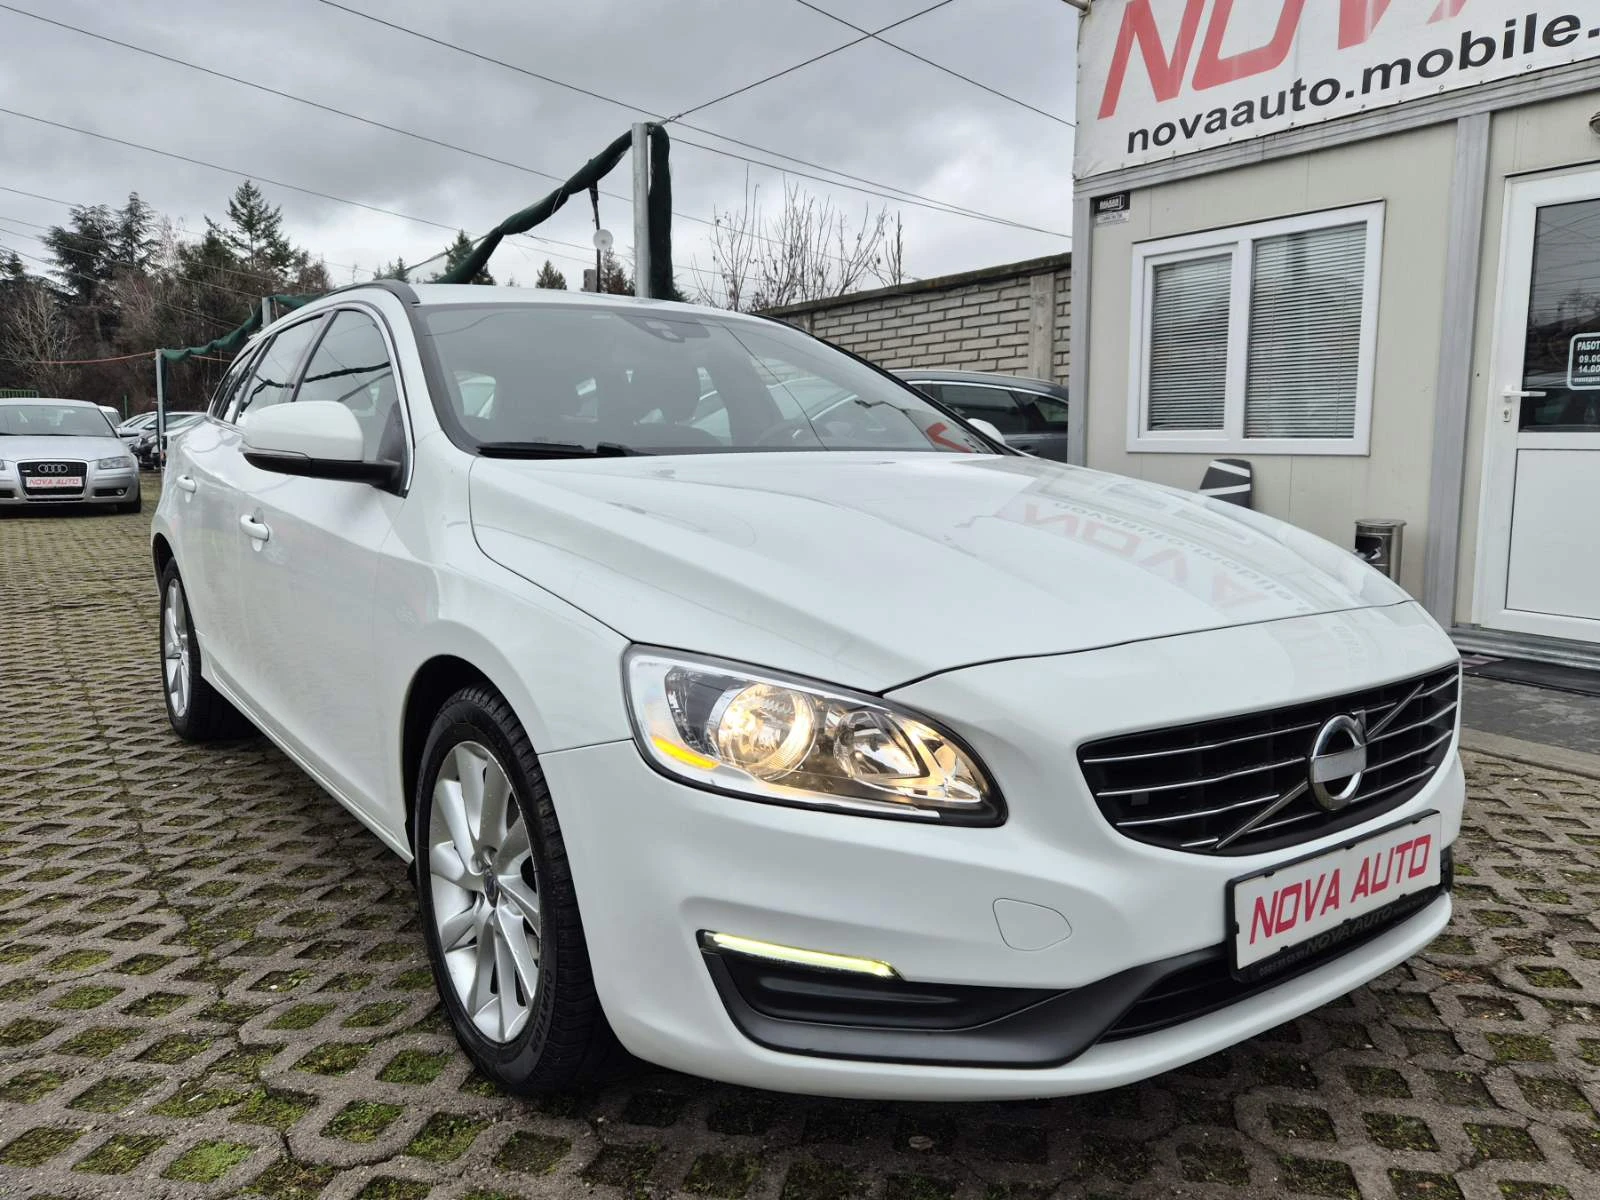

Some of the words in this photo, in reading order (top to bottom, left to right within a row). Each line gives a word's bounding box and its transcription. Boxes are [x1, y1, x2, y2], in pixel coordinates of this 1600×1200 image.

[29, 478, 53, 486] NOVA
[56, 478, 79, 486] AUTO
[1249, 868, 1341, 945] NOVA
[1350, 834, 1432, 904] AUTO
[1304, 924, 1351, 955] NOVA
[1351, 906, 1394, 934] AUTO
